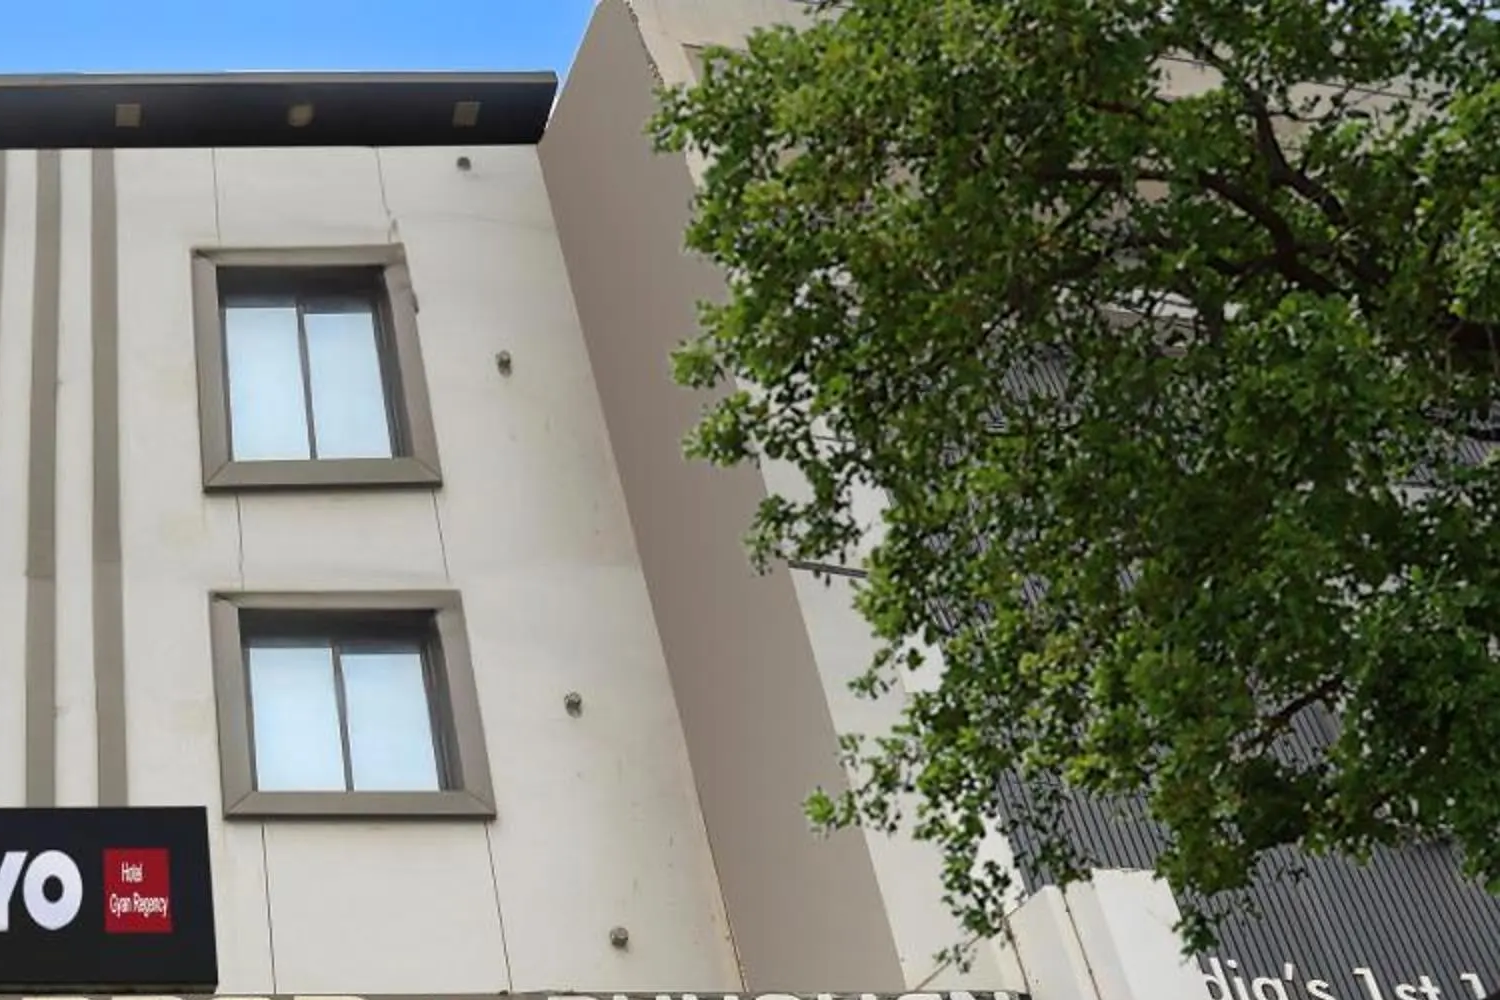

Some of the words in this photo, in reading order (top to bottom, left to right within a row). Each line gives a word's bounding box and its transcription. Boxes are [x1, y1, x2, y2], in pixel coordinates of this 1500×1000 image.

[121, 862, 143, 882] Hotel
[109, 893, 132, 918] Gyan
[133, 892, 169, 918] Regency
